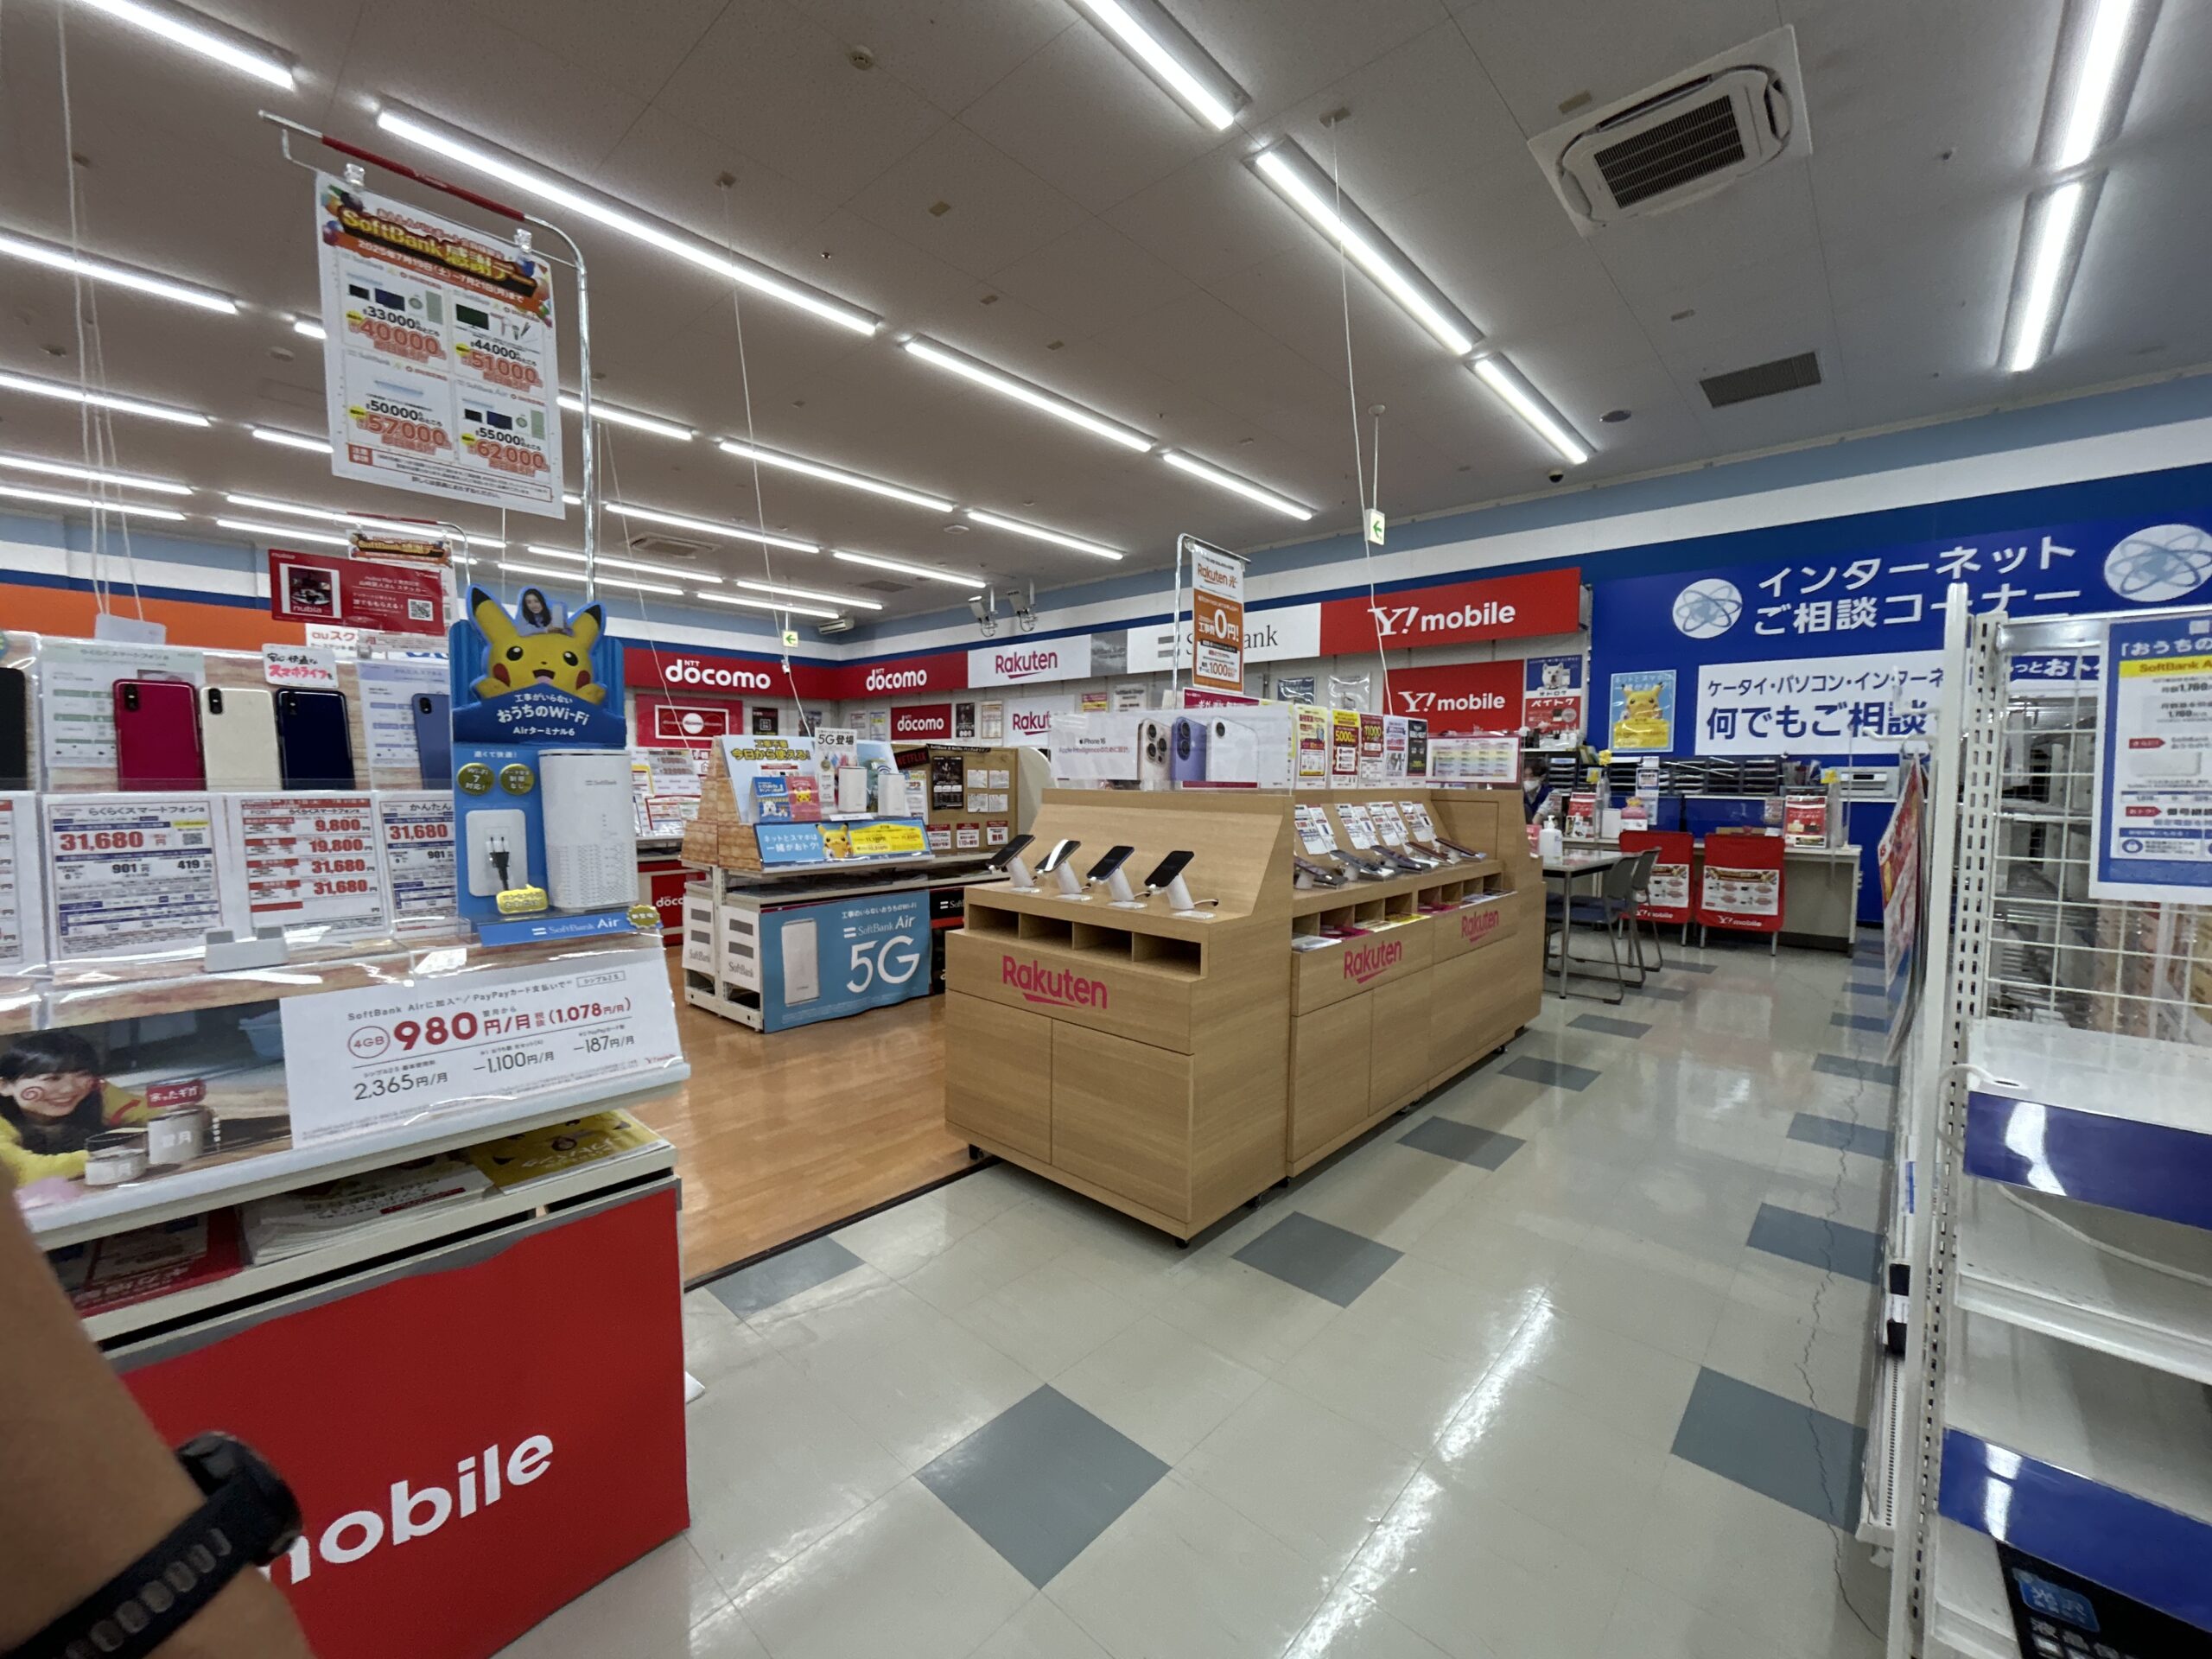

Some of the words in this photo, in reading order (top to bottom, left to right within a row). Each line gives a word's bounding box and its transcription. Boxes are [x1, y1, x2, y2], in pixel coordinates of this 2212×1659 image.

[342, 209, 440, 257] SoftBank
[1758, 536, 2076, 598] インターネット
[1198, 563, 1228, 584] Rakuten
[1229, 575, 1238, 588] 光
[293, 606, 322, 614] nubia
[995, 650, 1058, 675] Rakuten
[2139, 661, 2199, 674] SoftBank
[665, 659, 771, 690] docomo
[866, 669, 927, 691] docomo
[514, 693, 574, 704] 工事がいらない
[1531, 698, 1575, 707] ペイトク
[497, 704, 590, 726] おうちのWi-Fi
[1706, 699, 1928, 741] 何でもご相談
[513, 726, 575, 736] Airターミナル6
[897, 715, 944, 732] docomo
[817, 734, 855, 746] 5G登場
[731, 748, 811, 761] 今日から使える!
[315, 818, 360, 832] 9,800
[390, 824, 448, 840] 31,680
[60, 830, 143, 851] 31,680
[309, 838, 364, 853] 19,800
[111, 863, 137, 874] 901
[312, 859, 365, 874] 31,680
[314, 880, 368, 895] 31,680
[548, 924, 596, 934] SoftBank
[597, 918, 620, 930] Air
[858, 922, 894, 936] SoftBank
[895, 915, 916, 930] Air
[1461, 909, 1500, 938] Rakuten
[689, 949, 711, 963] SoftBank
[847, 935, 921, 993] 5G
[1344, 939, 1402, 980] Rakuten
[728, 962, 754, 978] SoftBank
[1002, 955, 1108, 1009] Rakuten
[347, 1006, 402, 1021] SoftBank
[393, 1012, 479, 1052] 980
[484, 1014, 531, 1037] 円/月
[353, 1036, 385, 1049] 4GB
